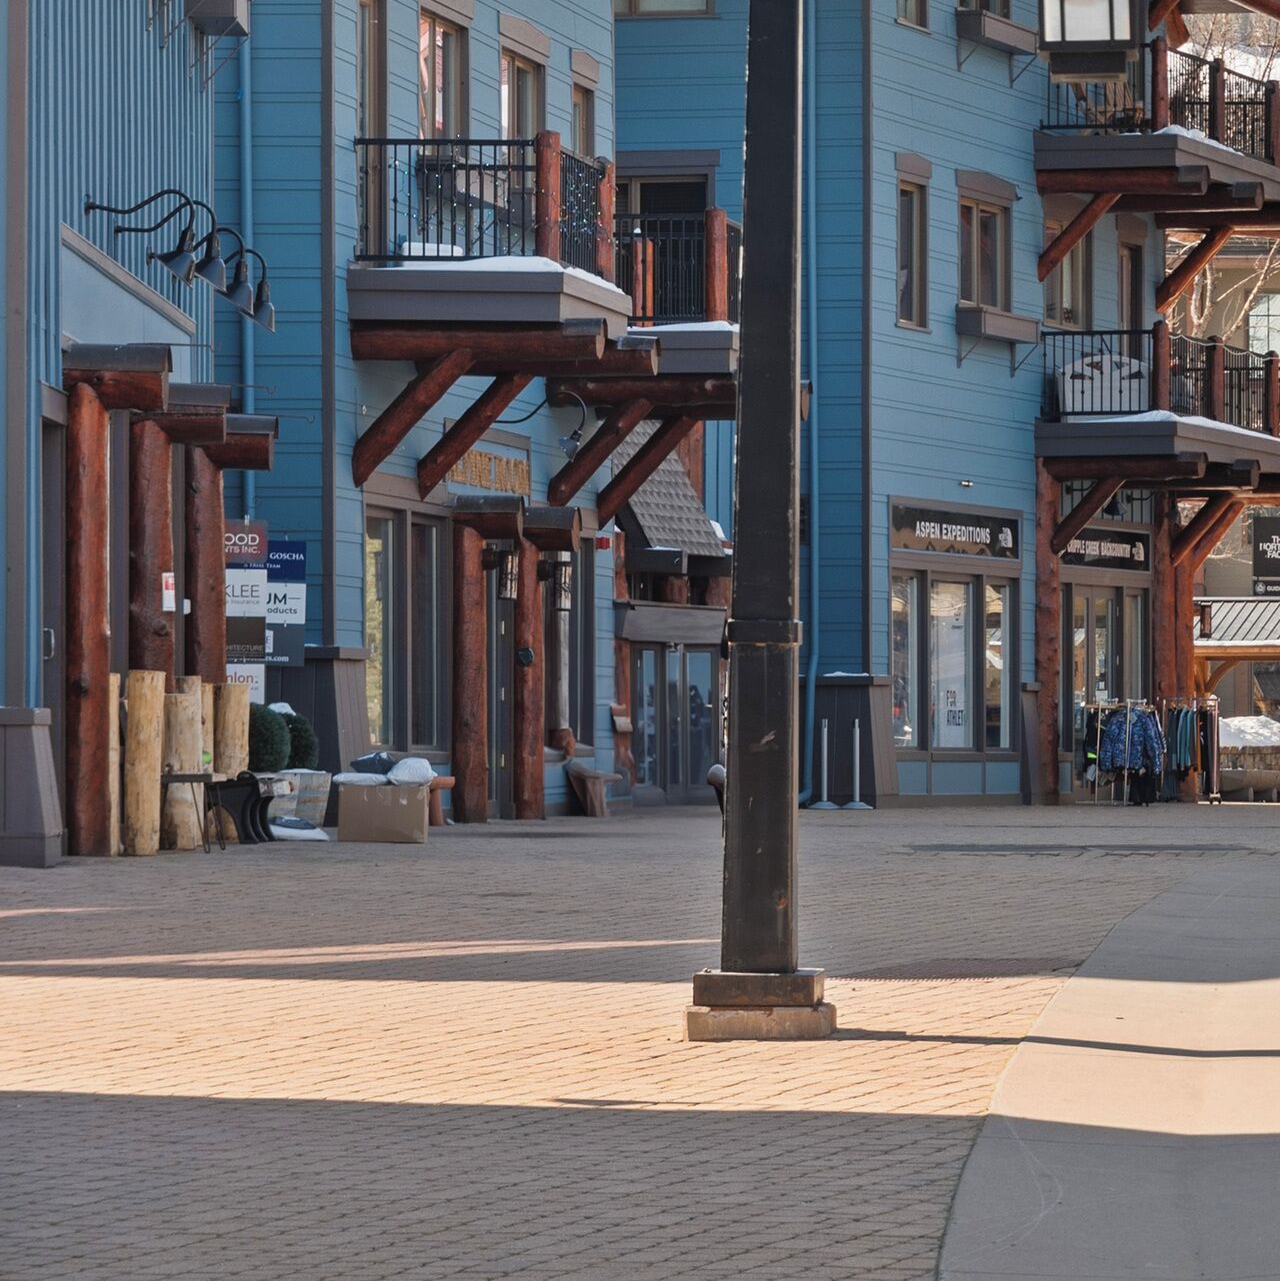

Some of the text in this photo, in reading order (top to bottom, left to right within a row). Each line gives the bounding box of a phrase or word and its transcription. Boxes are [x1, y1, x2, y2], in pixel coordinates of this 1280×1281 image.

[915, 521, 940, 538] ASPEN
[942, 524, 991, 544] EXPEDITIONS
[1085, 540, 1100, 555] CREEK
[269, 552, 305, 560] GOSCHA
